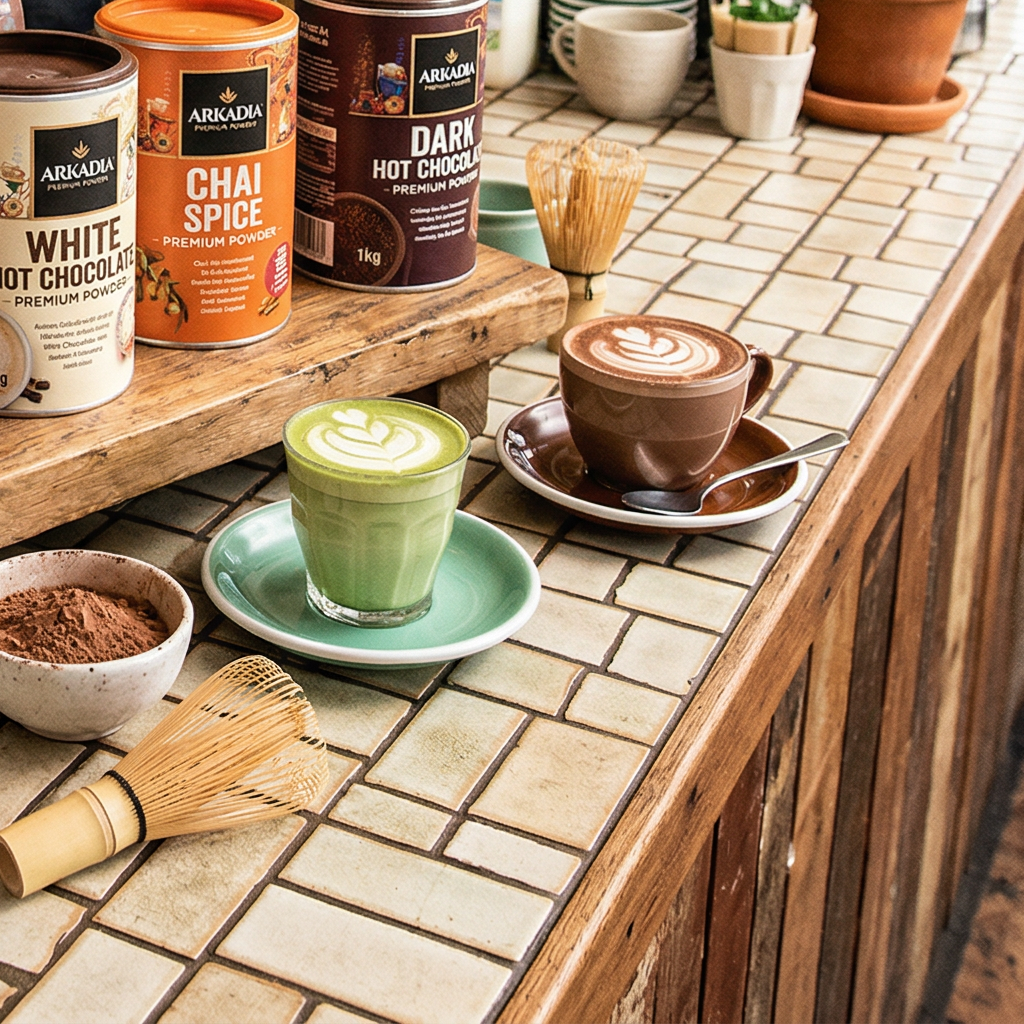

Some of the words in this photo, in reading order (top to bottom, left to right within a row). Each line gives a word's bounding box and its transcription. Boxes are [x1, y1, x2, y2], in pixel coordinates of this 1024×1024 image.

[419, 61, 476, 84] ARKADIA
[187, 103, 263, 123] ARKADIA
[410, 114, 476, 158] DARK
[40, 156, 115, 182] ARKADIA
[372, 159, 413, 180] HOT
[186, 162, 262, 201] CHAI
[183, 197, 263, 233] SPICE
[26, 215, 121, 263] WHITE
[163, 235, 225, 248] PREMIUM
[229, 226, 277, 246] POWDER
[357, 247, 382, 267] 1kg
[14, 292, 79, 308] PREMIUM
